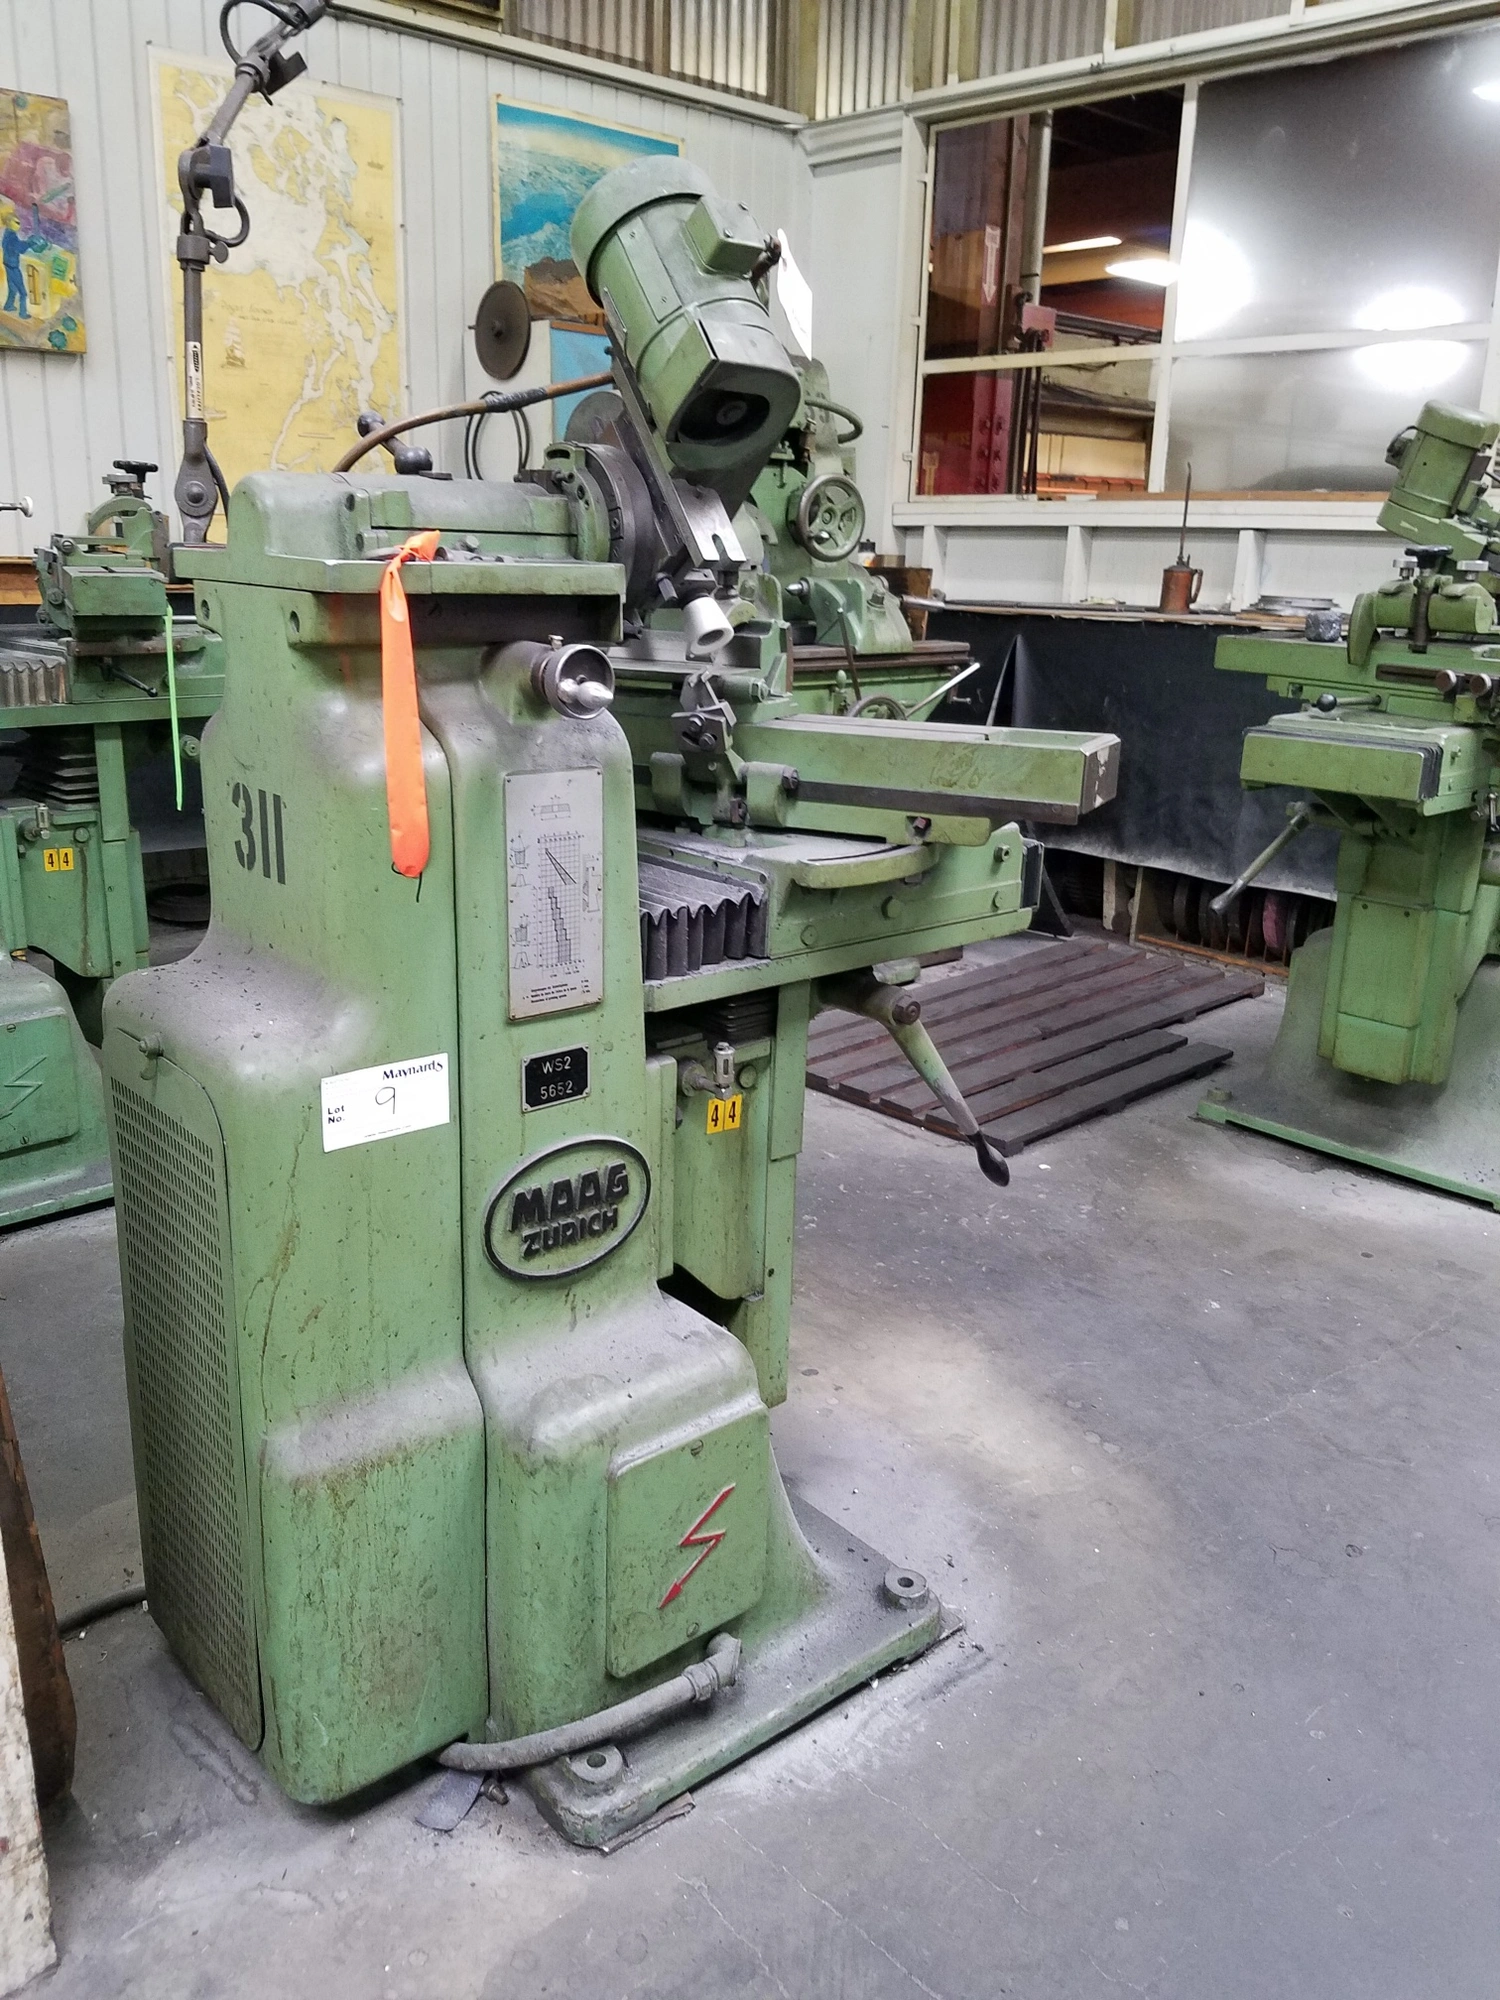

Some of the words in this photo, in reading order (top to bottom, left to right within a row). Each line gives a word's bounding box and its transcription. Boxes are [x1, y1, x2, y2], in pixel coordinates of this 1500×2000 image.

[231, 782, 286, 885] 311
[47, 852, 70, 868] 44
[382, 1060, 444, 1081] Maynards
[541, 1055, 572, 1075] WS2
[374, 1086, 396, 1115] 9
[540, 1080, 574, 1100] 5652
[327, 1104, 345, 1115] Lot
[327, 1115, 346, 1125] No.
[710, 1100, 737, 1128] 44
[508, 1159, 629, 1232] MAAG
[521, 1203, 618, 1260] ZURICH
